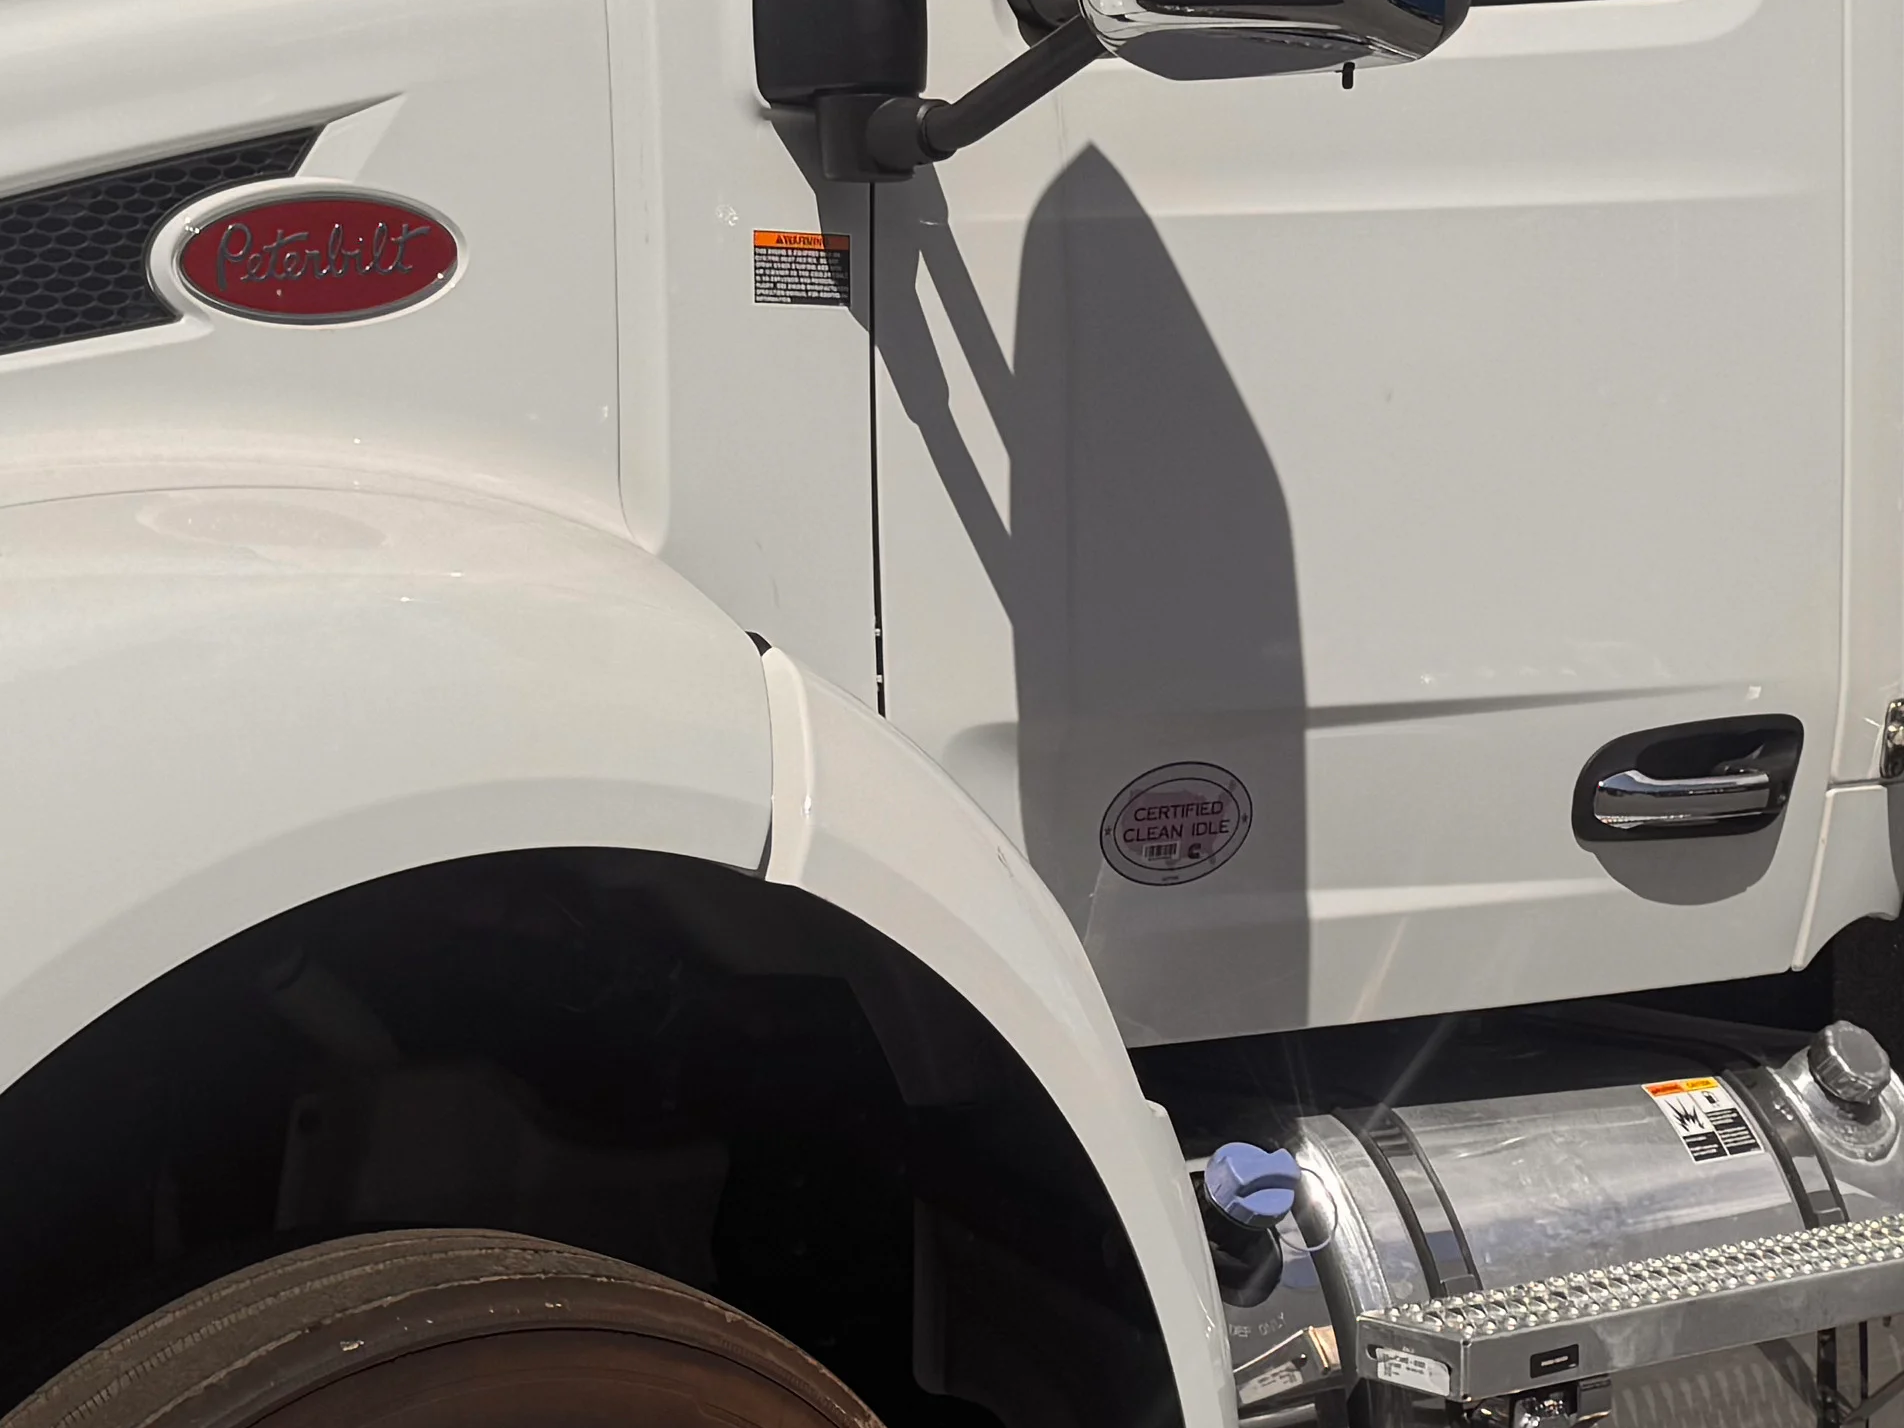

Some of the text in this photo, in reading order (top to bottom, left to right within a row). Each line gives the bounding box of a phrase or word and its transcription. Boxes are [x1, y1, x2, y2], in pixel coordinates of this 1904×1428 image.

[215, 222, 431, 292] Peterbilt
[1134, 800, 1224, 822] CERTIFIED
[1123, 819, 1231, 843] CLEAN IDLE
